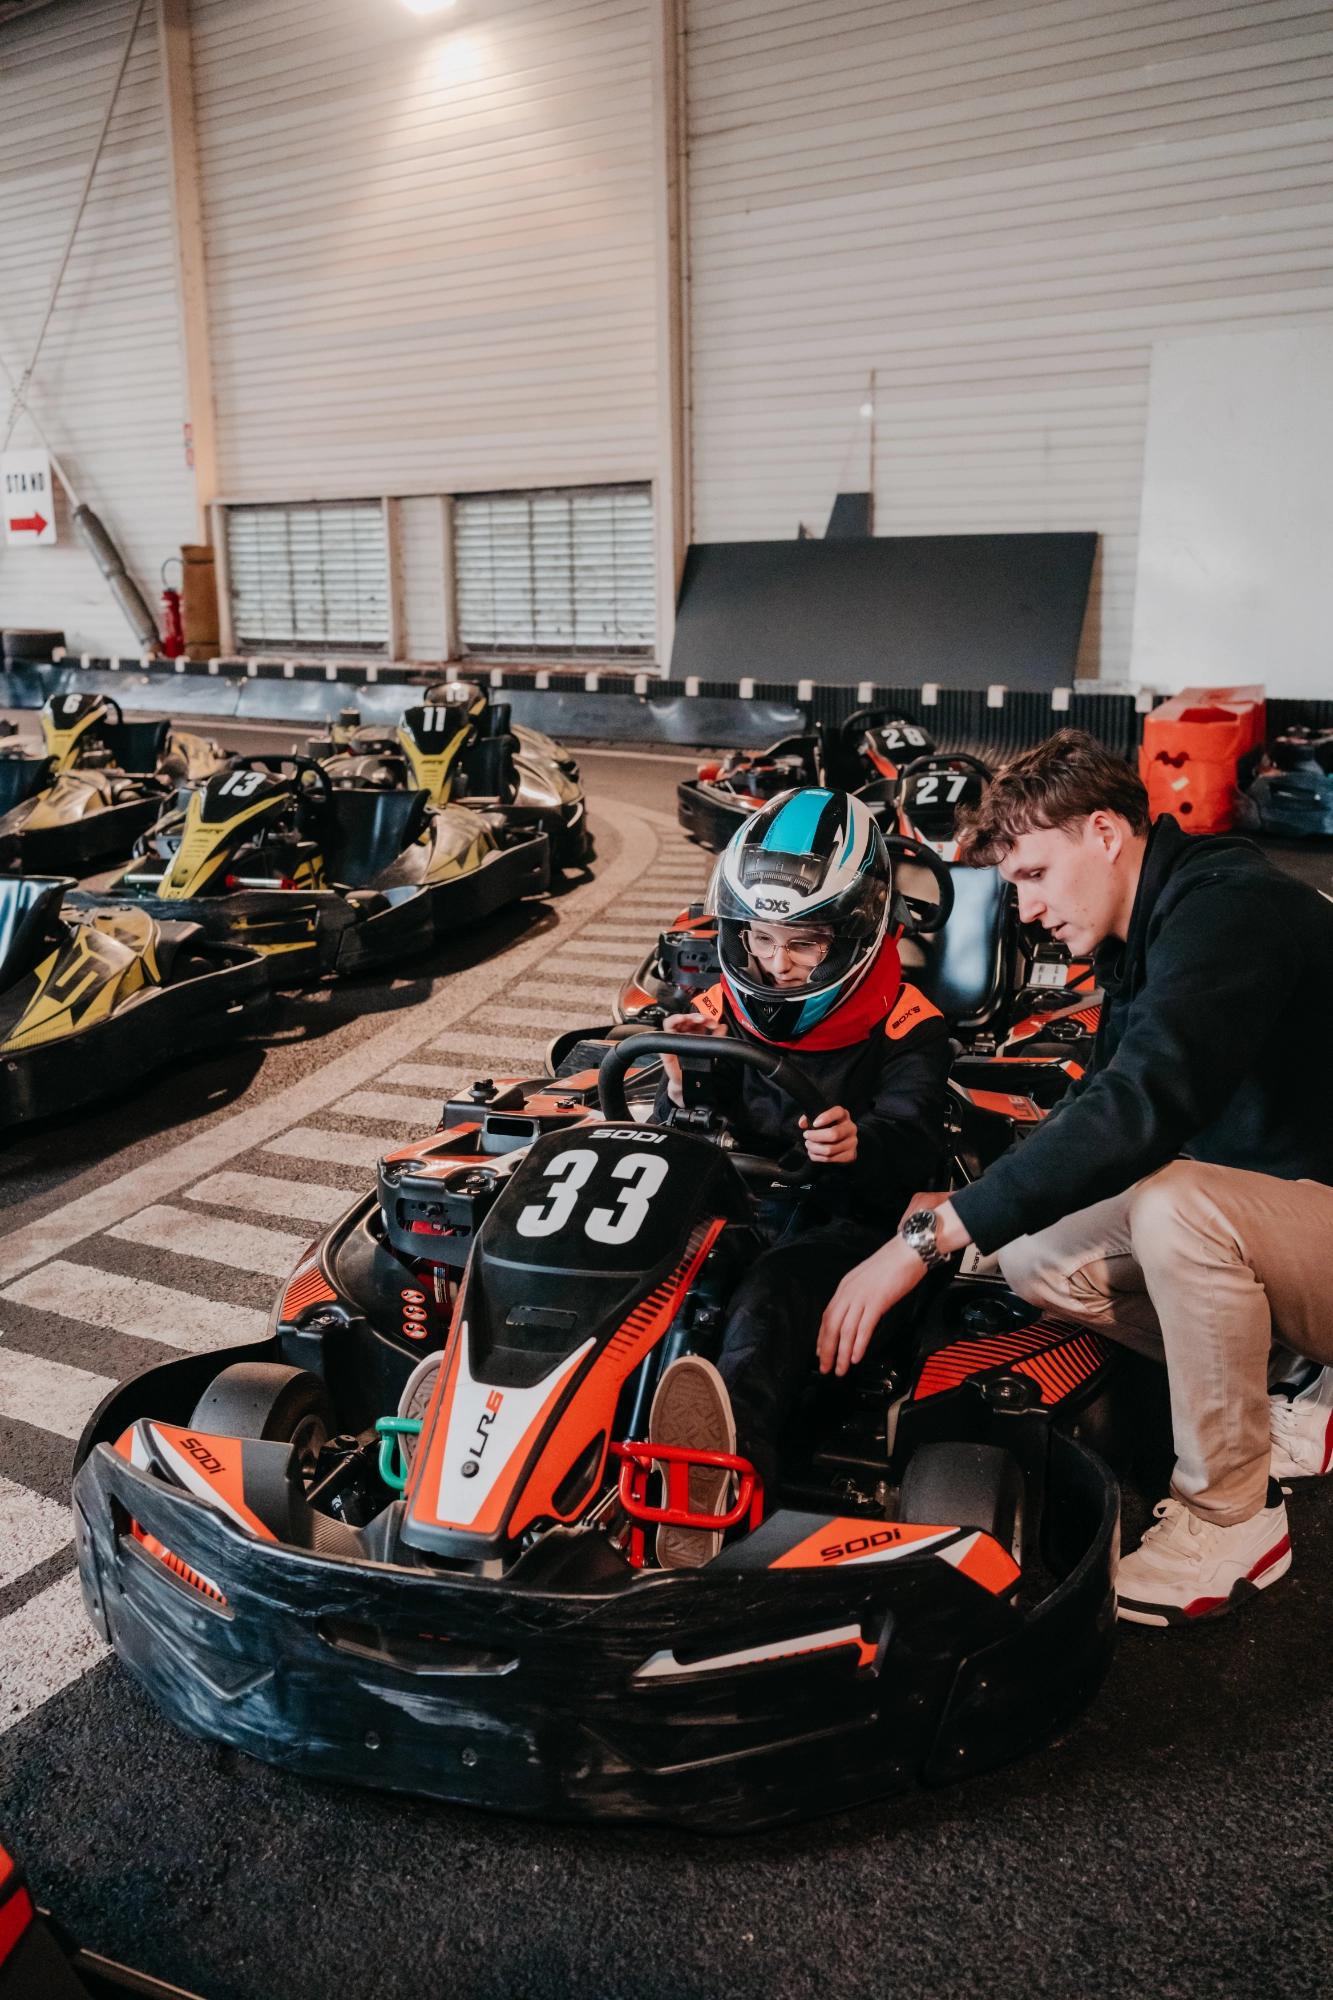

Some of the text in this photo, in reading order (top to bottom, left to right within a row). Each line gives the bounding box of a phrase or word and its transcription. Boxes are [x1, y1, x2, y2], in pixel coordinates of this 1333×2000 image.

[7, 472, 44, 493] STAND
[62, 694, 82, 714] 6
[422, 706, 447, 732] 11
[881, 727, 926, 749] 28
[218, 770, 267, 797] 13
[916, 775, 967, 805] 27
[892, 1006, 921, 1029] BOX'S
[588, 1129, 668, 1143] SODI
[516, 1149, 669, 1245] 33
[469, 1389, 504, 1458] LR6
